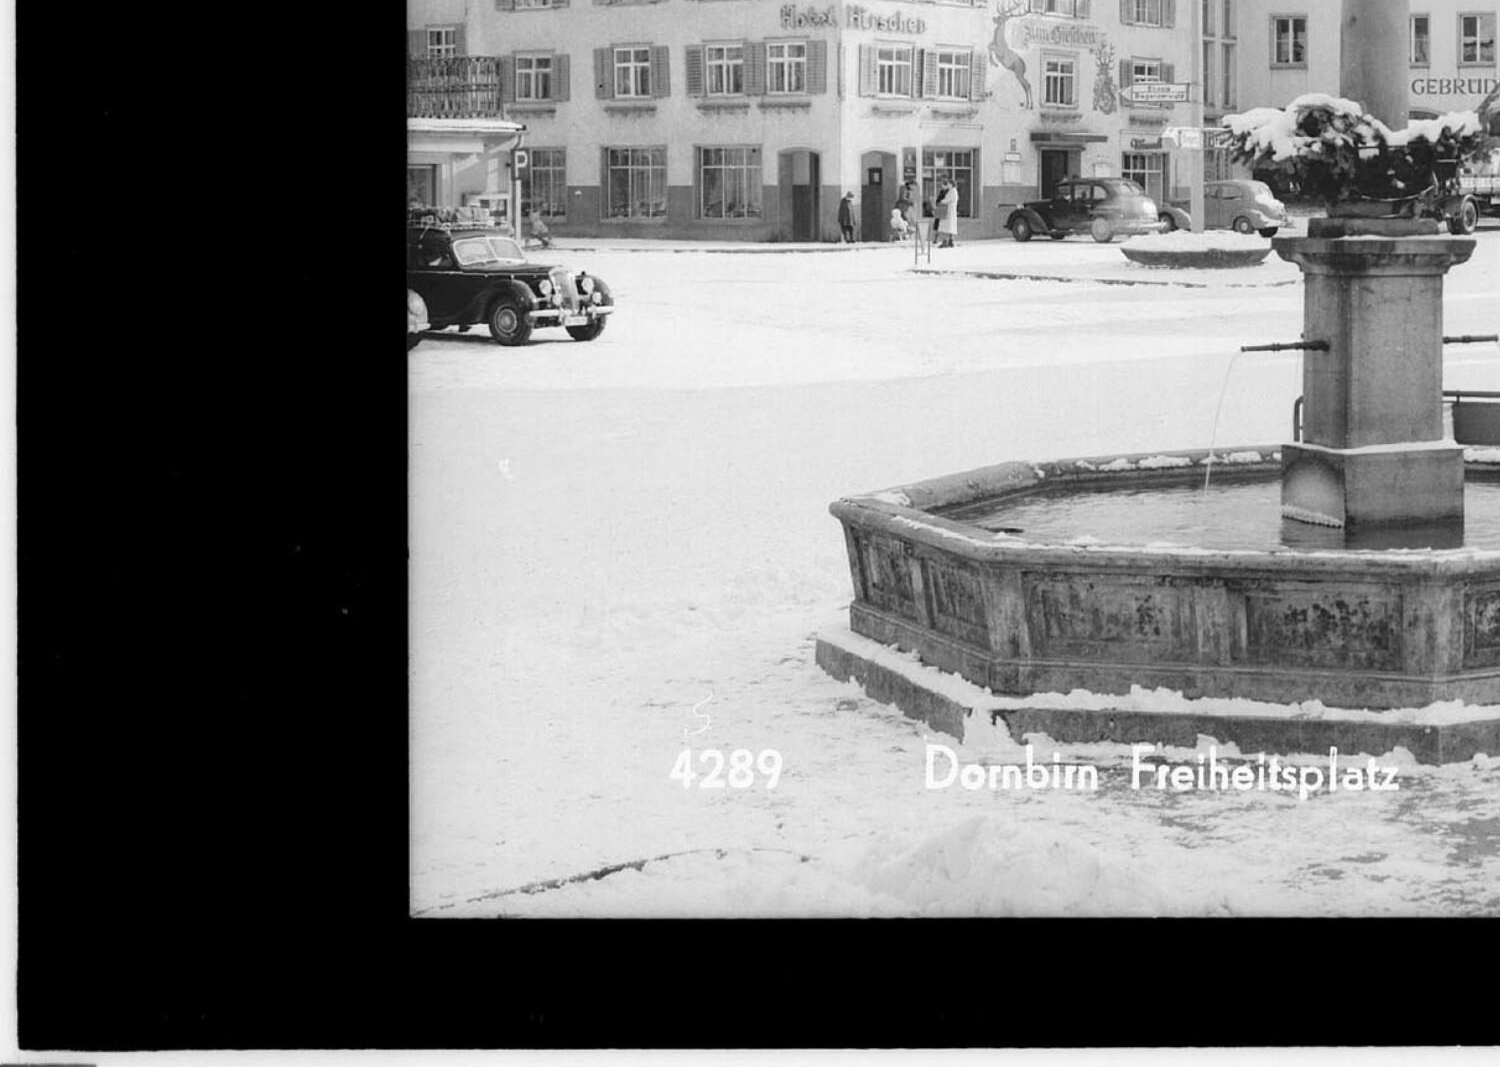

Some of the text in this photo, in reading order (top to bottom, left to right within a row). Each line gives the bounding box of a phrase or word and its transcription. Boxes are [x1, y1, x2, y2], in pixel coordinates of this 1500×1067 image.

[779, 4, 928, 35] Hotel Hirschen
[515, 151, 528, 178] P
